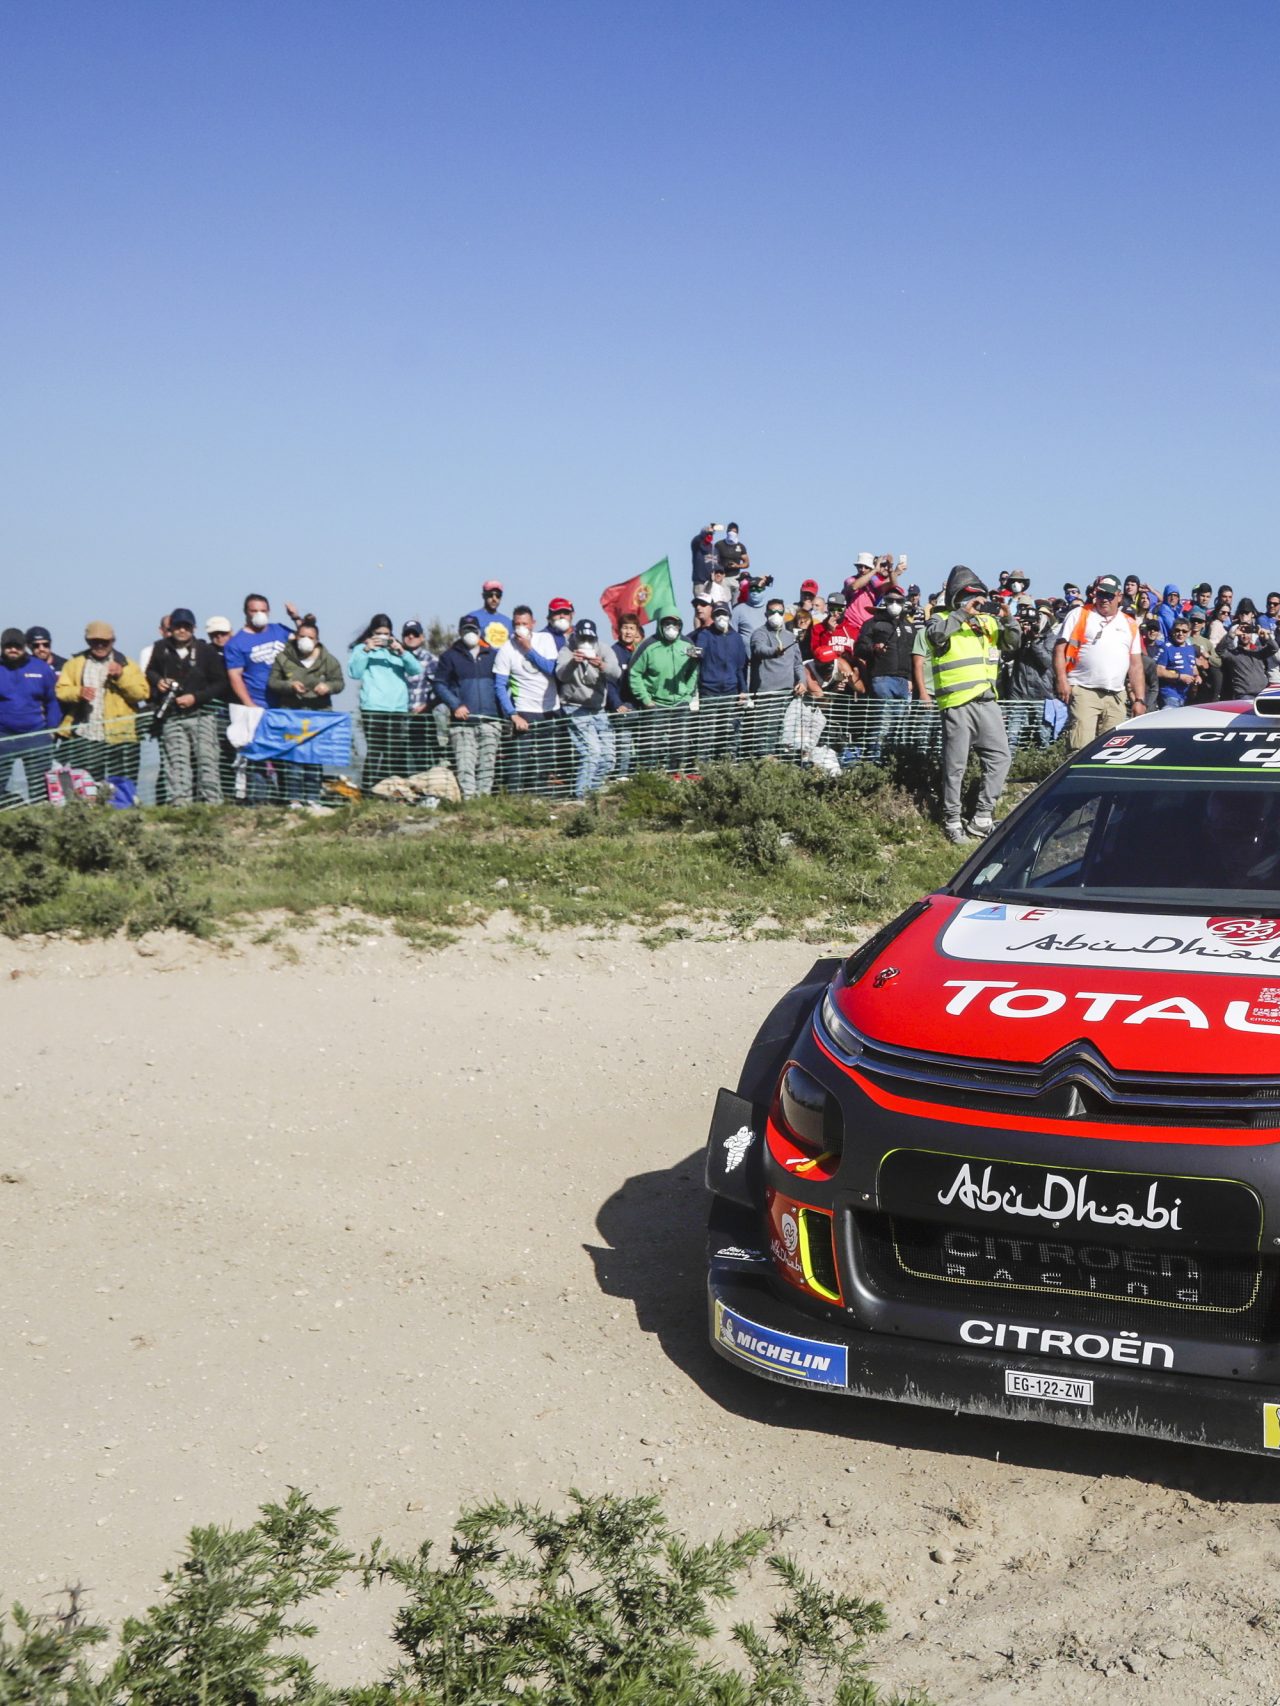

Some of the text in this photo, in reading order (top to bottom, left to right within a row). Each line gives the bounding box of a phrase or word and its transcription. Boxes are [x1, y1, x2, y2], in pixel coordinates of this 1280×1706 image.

[1020, 909, 1053, 921] E
[1005, 933, 1127, 951] Abu
[937, 1163, 1183, 1231] Abu Dhabi
[736, 1331, 831, 1371] MICHELIN
[959, 1319, 1175, 1368] CITROËN
[1013, 1376, 1085, 1399] EG-122-ZW
